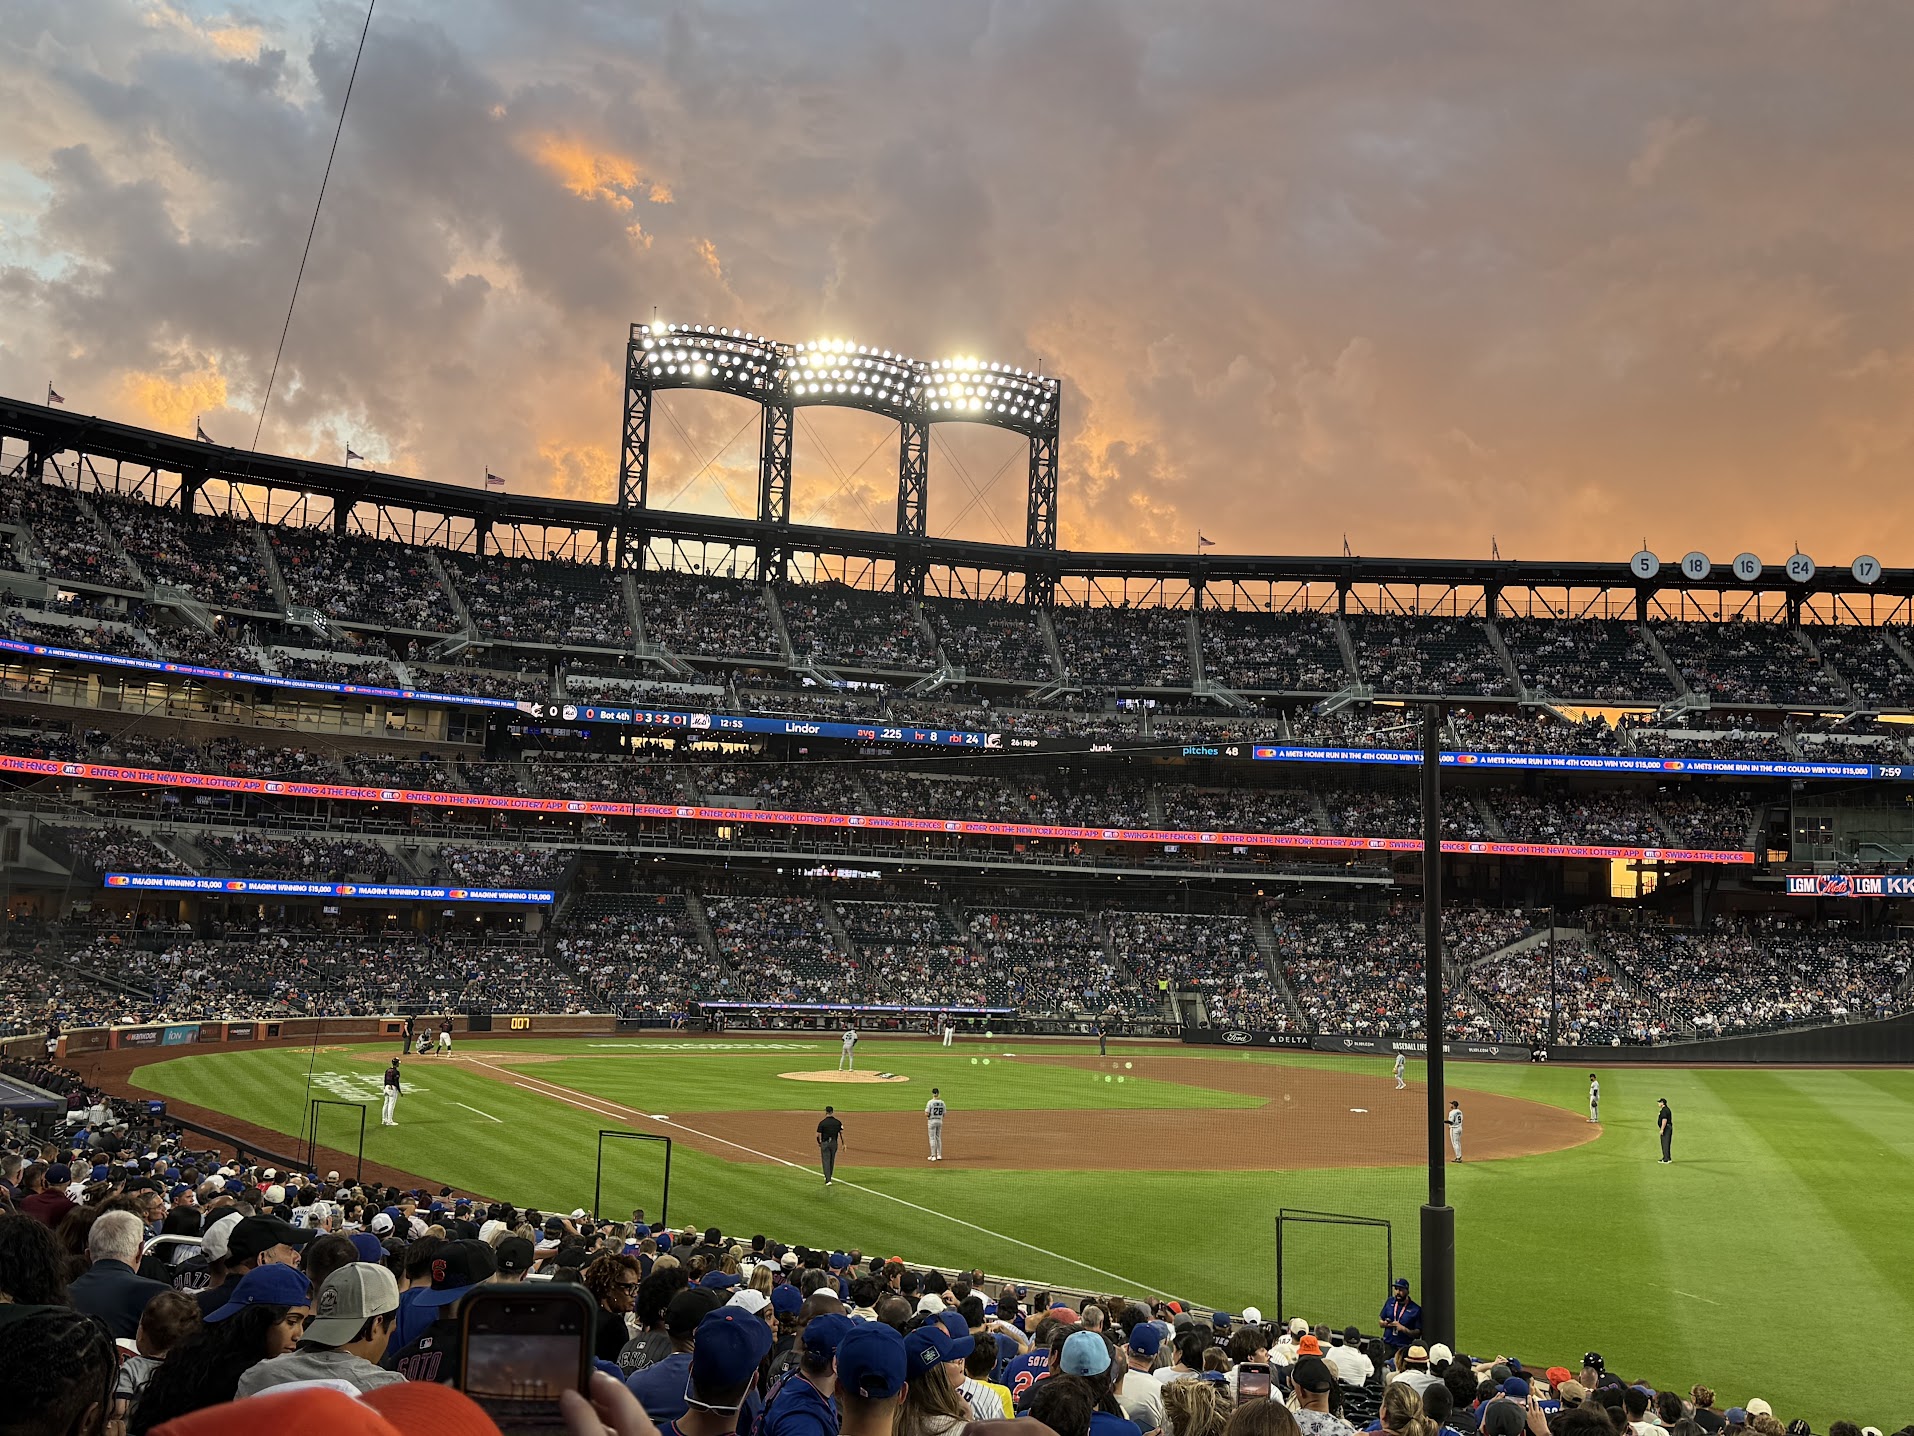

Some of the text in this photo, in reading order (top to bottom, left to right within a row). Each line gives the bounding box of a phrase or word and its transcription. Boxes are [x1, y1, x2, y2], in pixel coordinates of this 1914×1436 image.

[1640, 558, 1649, 571] 5
[1689, 560, 1702, 572] 18
[1740, 560, 1754, 573] 16
[1792, 562, 1809, 574] 24
[1860, 563, 1872, 576] 17
[550, 706, 558, 716] 0
[586, 709, 630, 720] 0 Bot 4th
[786, 722, 979, 744] Lindor avg .225 hr 8 rbi 24
[1090, 744, 1112, 752] Junk
[1182, 746, 1238, 756] pitches 48
[2, 758, 7, 767] 4
[9, 759, 24, 769] THE
[26, 761, 58, 772] FENCES
[1635, 761, 1661, 770] $15,000
[1842, 768, 1868, 776] $15,000
[1880, 768, 1901, 776] 7:59
[91, 767, 119, 778] ENTER
[121, 770, 136, 779] ON
[138, 772, 155, 781] THE
[157, 773, 177, 783] NEW
[180, 775, 203, 785] YORK
[206, 778, 241, 788] LOTTERY
[243, 781, 260, 789] APP
[288, 784, 319, 794] SWING
[327, 787, 343, 795] THE
[345, 788, 376, 798] FENCES
[406, 793, 432, 801] ENTER
[466, 797, 485, 805] NEW
[487, 798, 508, 806] YORK
[511, 799, 544, 808] LOTTERY
[590, 804, 617, 812] SWING
[644, 807, 673, 815] FENCES
[796, 815, 828, 823] LOTTERY
[132, 878, 222, 889] IMAGINE WINNING $15,000
[249, 883, 331, 894] IMAGINE WINNING $15,000
[1790, 878, 1814, 892] LGM
[1856, 878, 1881, 893] LGM
[420, 890, 445, 898] $15,000
[511, 1018, 530, 1030] 007
[1228, 1032, 1246, 1041] Ford
[397, 1351, 442, 1381] SOTO
[1028, 1356, 1049, 1367] SOTO
